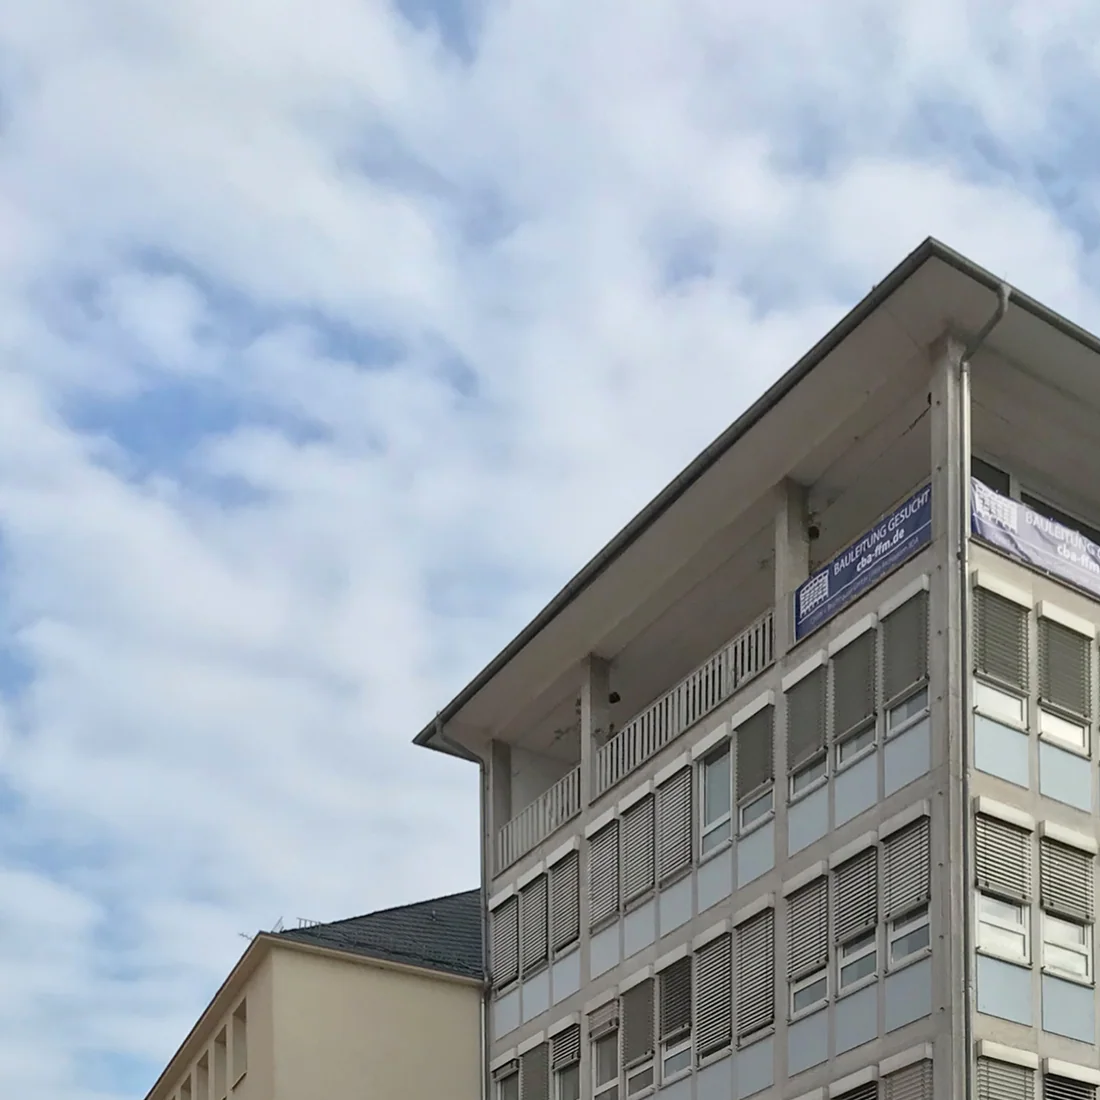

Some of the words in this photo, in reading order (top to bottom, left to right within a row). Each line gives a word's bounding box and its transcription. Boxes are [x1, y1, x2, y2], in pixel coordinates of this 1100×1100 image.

[833, 524, 887, 576] BAULEITUNG
[887, 488, 930, 532] GESUCHT
[856, 527, 905, 572] cba-ffm.de
[1025, 511, 1094, 555] BAULEITUNG
